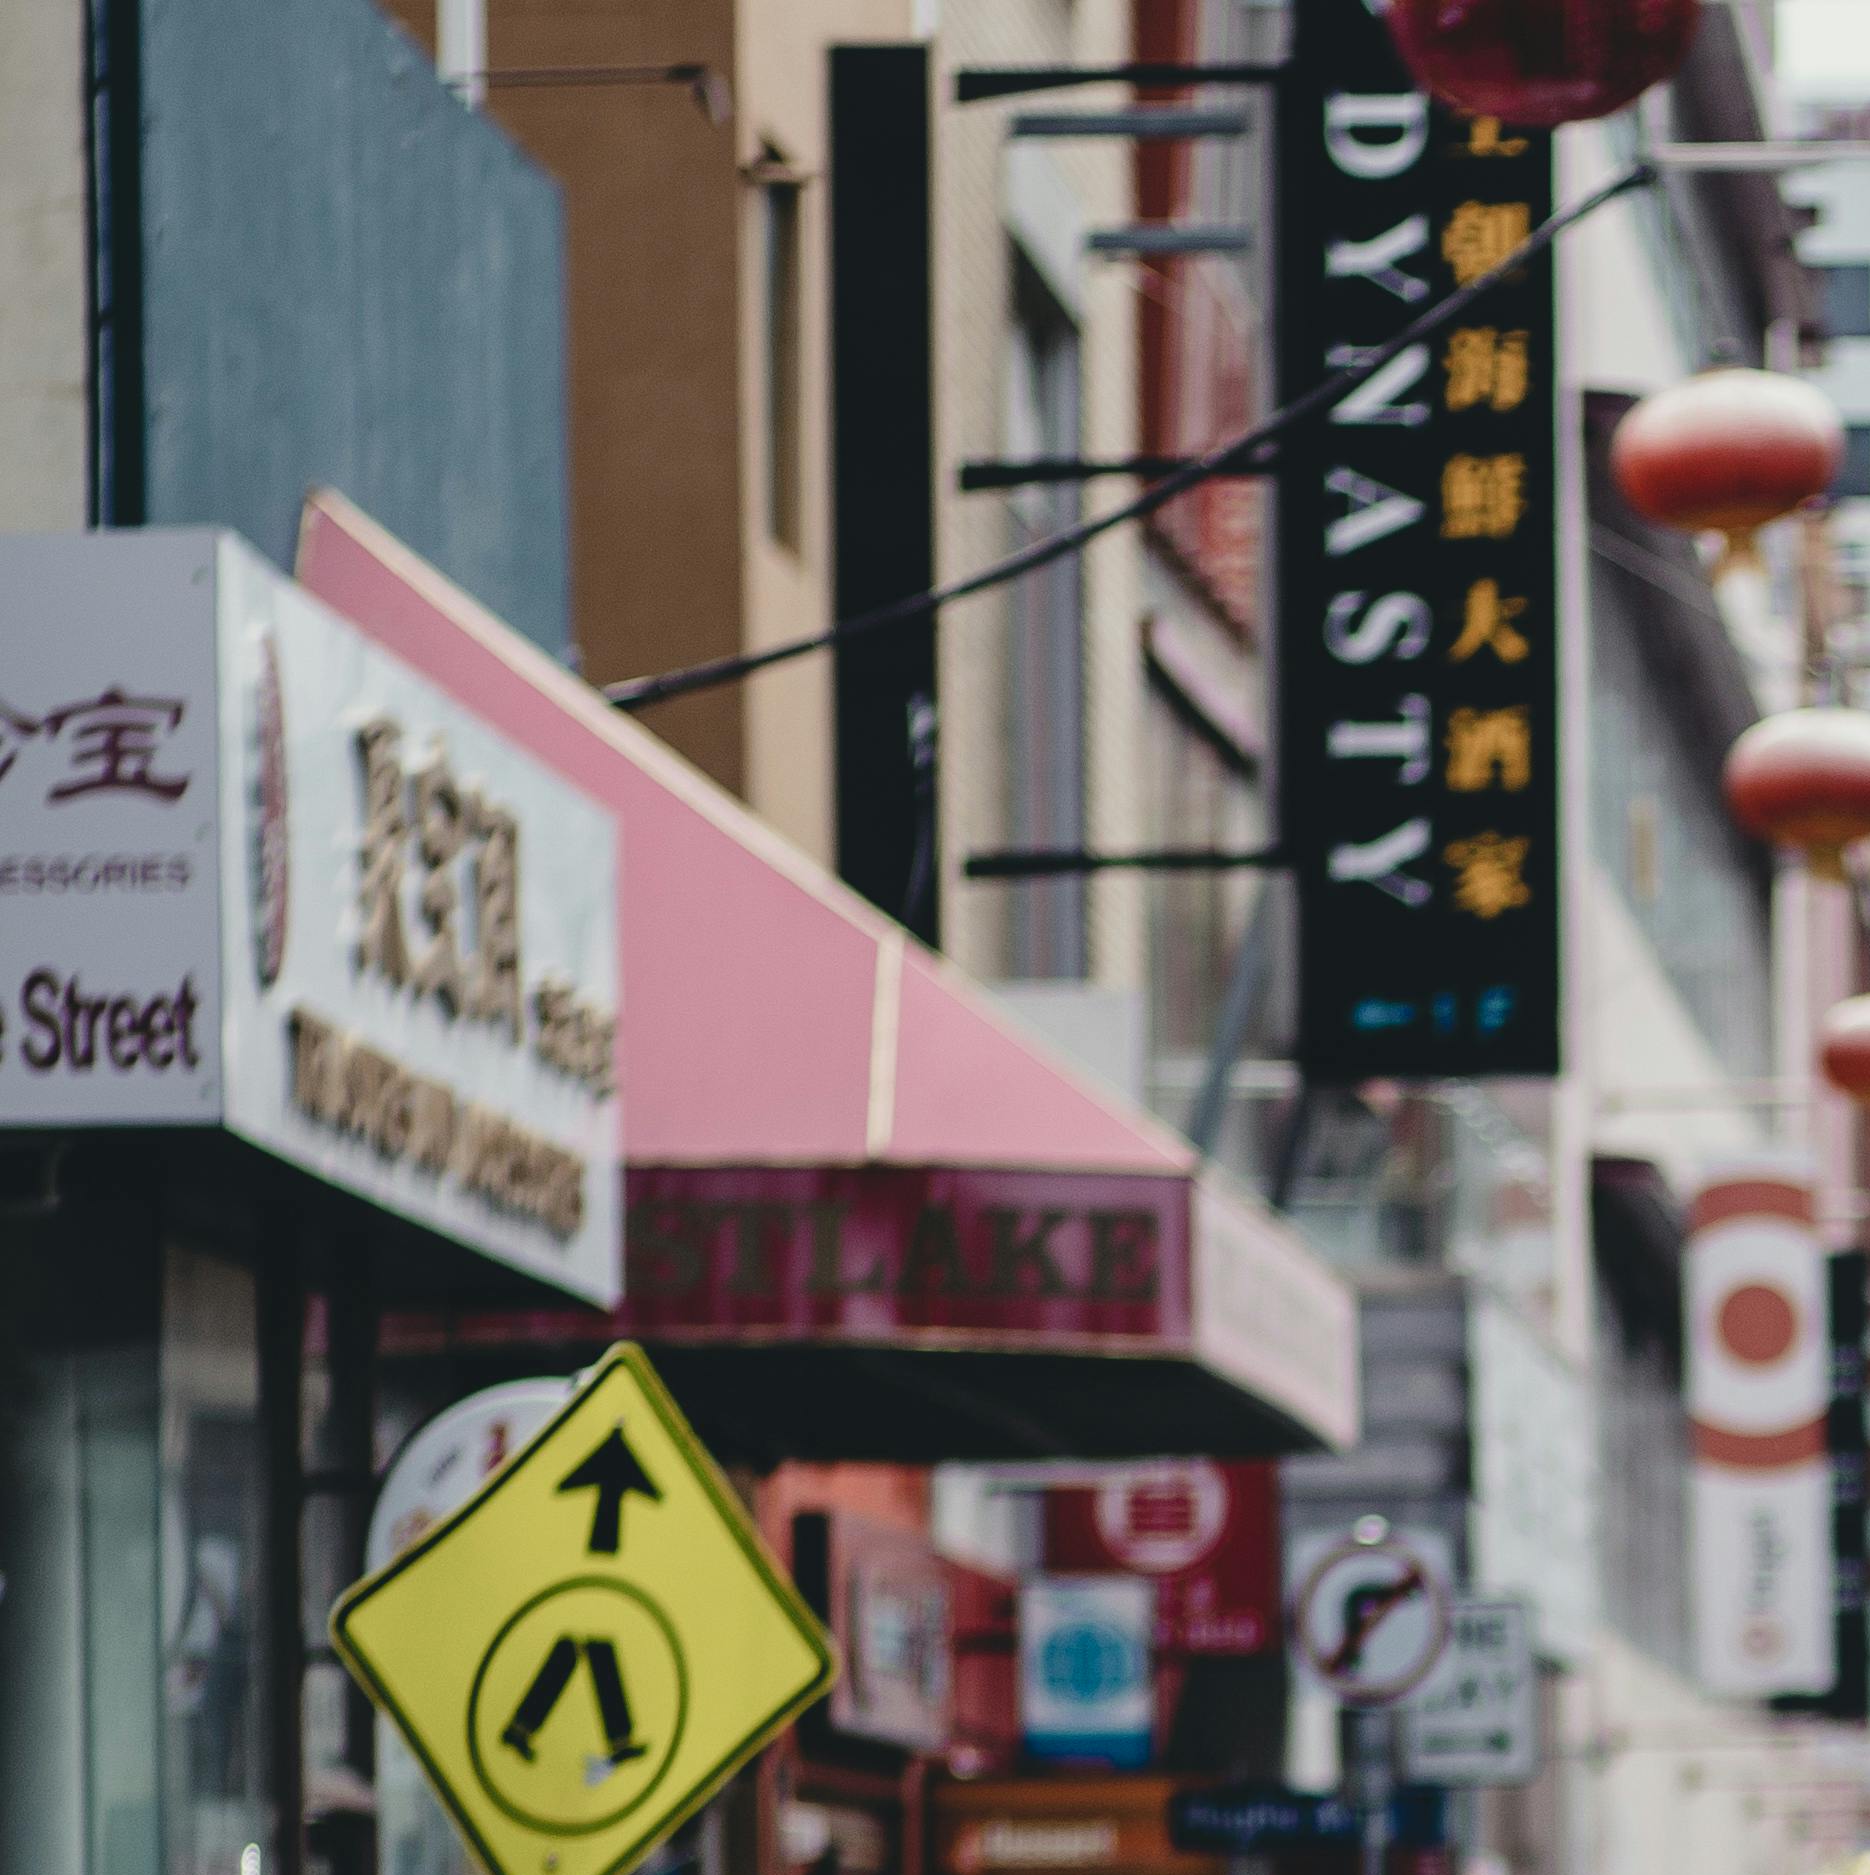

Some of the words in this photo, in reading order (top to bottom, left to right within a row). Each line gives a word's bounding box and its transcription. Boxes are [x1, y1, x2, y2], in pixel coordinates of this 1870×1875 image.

[1324, 90, 1432, 906] DYNASTY
[0, 683, 190, 804] 宝
[22, 966, 198, 1074] Street
